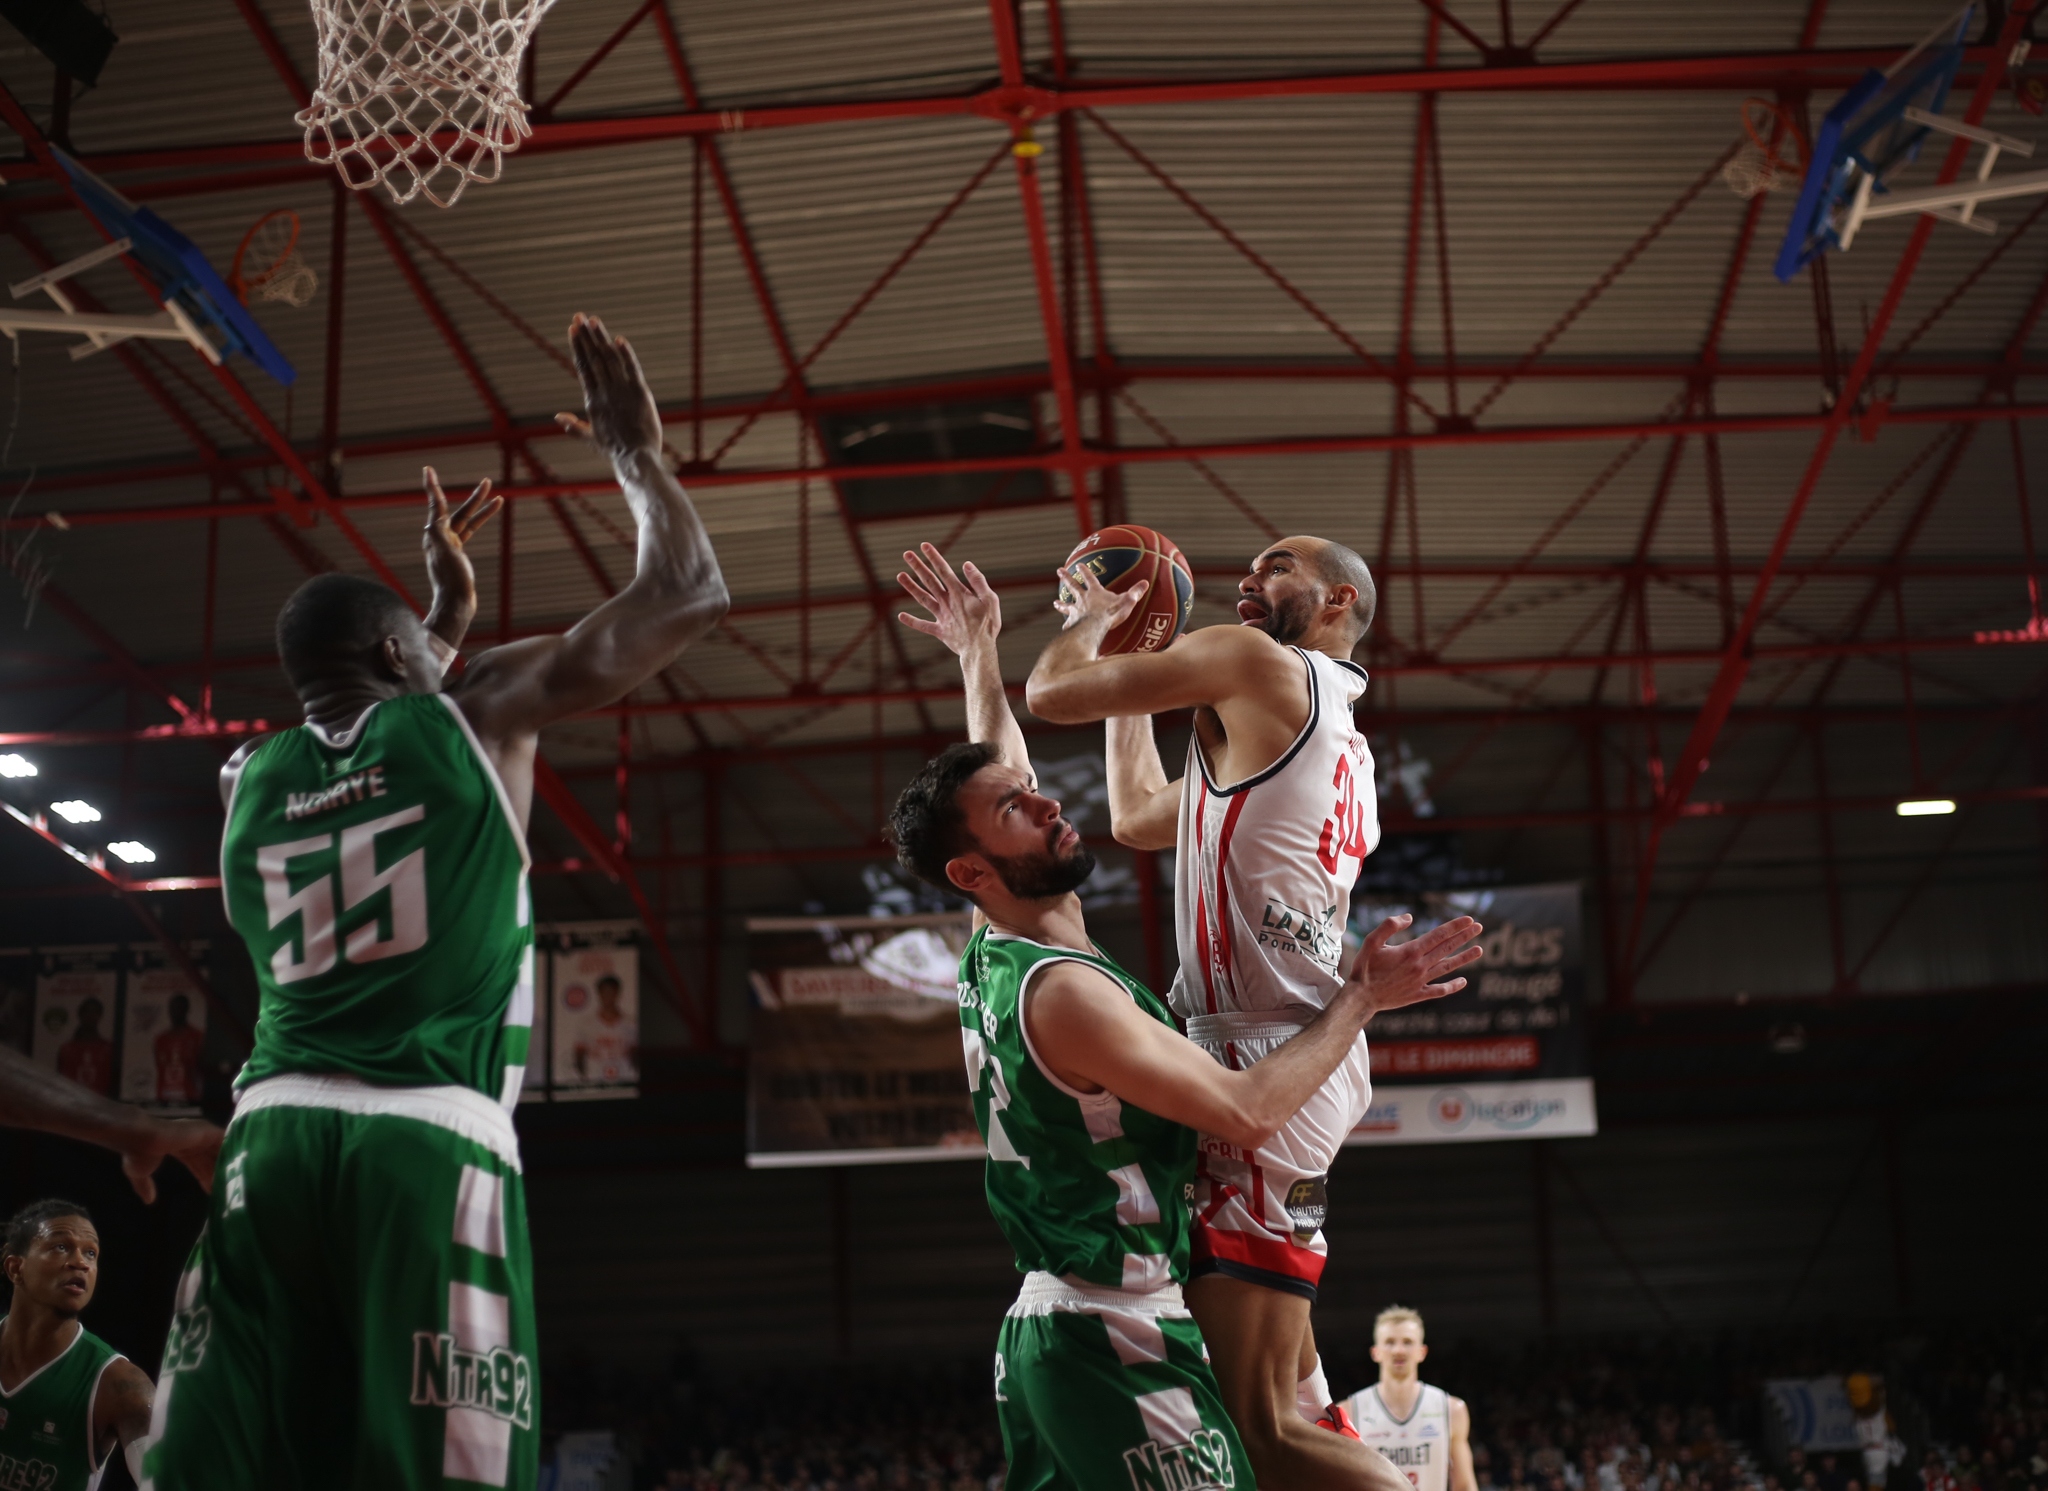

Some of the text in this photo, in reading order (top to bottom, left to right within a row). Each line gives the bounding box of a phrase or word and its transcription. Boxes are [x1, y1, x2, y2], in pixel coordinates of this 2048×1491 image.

[1137, 617, 1169, 652] tclic
[286, 765, 387, 820] NDIAYE
[1316, 753, 1367, 880] 34
[257, 804, 428, 985] 55
[1262, 905, 1292, 931] LA
[1290, 1205, 1325, 1217] L'AUTRE
[410, 1331, 532, 1431] NTR92
[1122, 1429, 1235, 1491] NTR92
